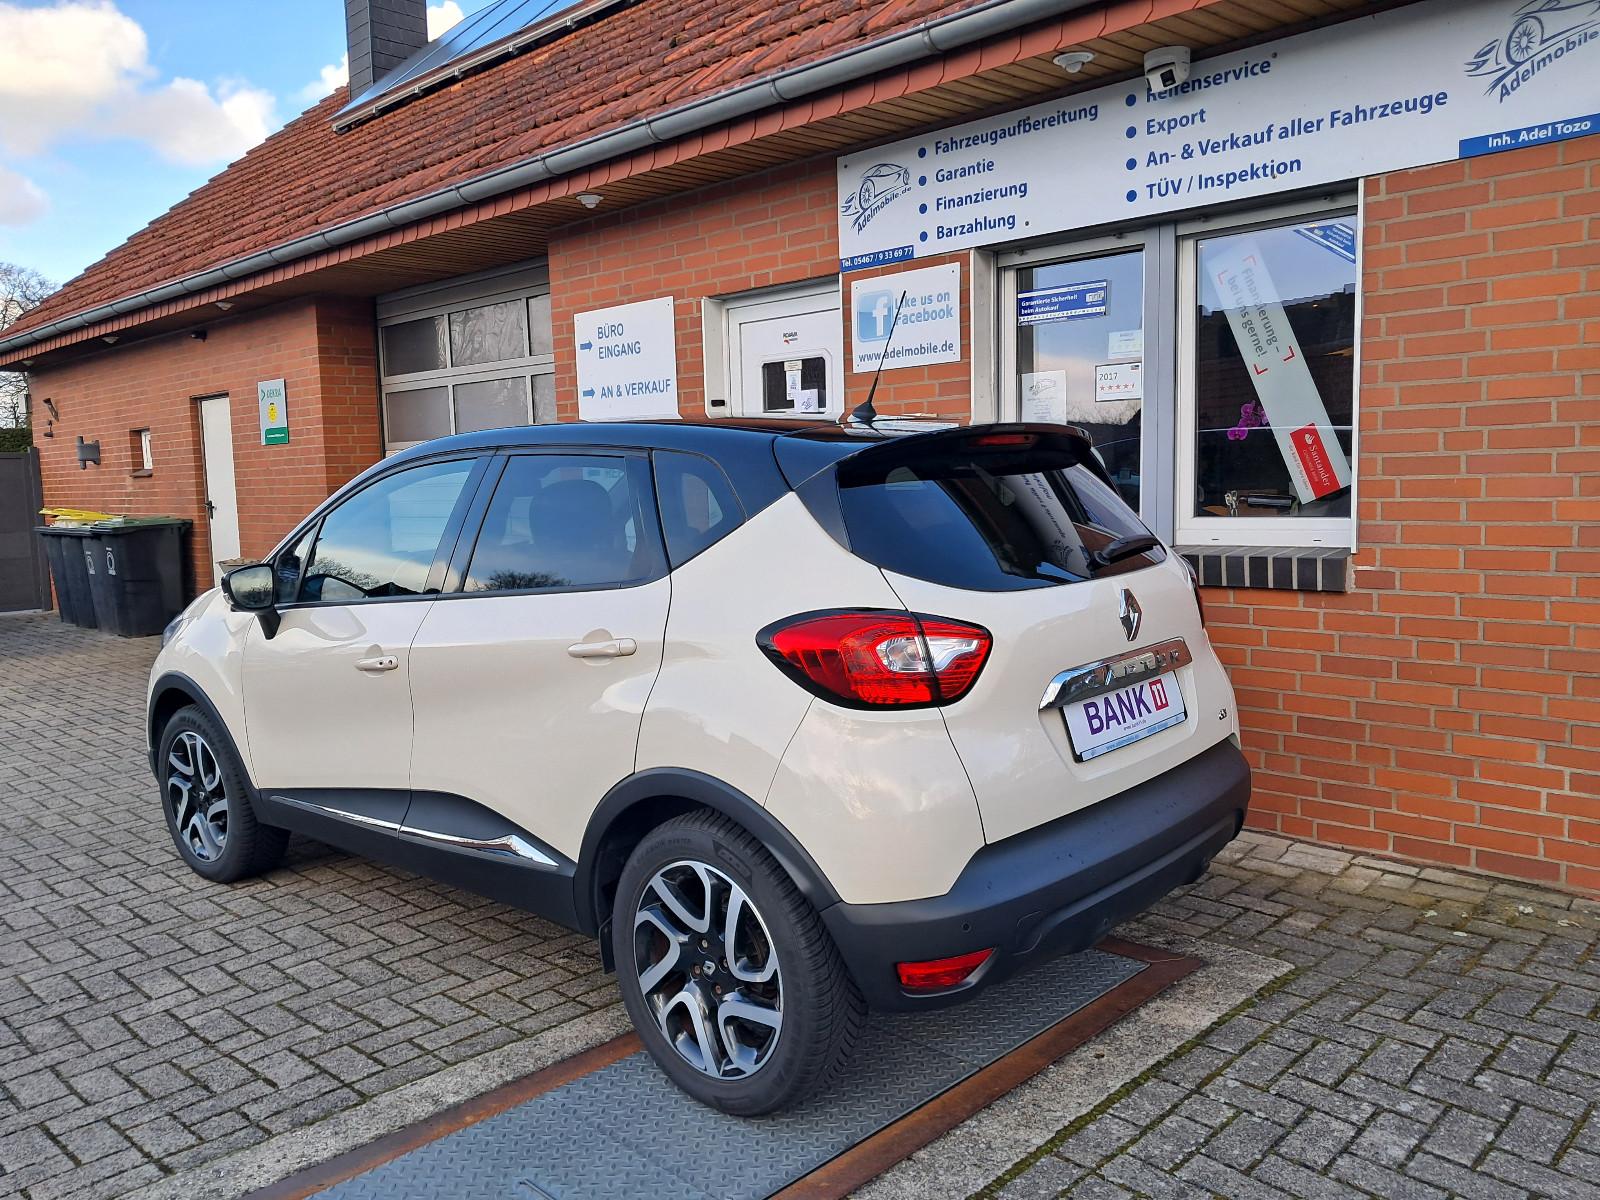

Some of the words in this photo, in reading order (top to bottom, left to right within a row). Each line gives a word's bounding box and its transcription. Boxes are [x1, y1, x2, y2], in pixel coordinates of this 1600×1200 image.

[1500, 31, 1599, 104] Adelmobile
[935, 104, 1099, 155] Fahrzeugaufbereitung
[1146, 149, 1176, 168] An-
[1181, 142, 1194, 160] &
[1198, 124, 1273, 157] Verkauf
[1278, 117, 1324, 141] aller
[1330, 91, 1448, 129] Fahrzeuge
[1147, 108, 1206, 137] Export
[1488, 133, 1515, 148] Inh.
[1518, 125, 1551, 142] Adel
[1555, 120, 1591, 135] Tozo
[935, 158, 994, 184] Garantie
[1146, 177, 1183, 200] TÜV
[1187, 175, 1194, 194] /
[1198, 156, 1302, 191] Inspektion
[857, 186, 911, 235] Adelmobile.de
[935, 181, 1028, 212] Finanzierung
[936, 212, 1016, 240] Barzahlung
[842, 259, 853, 268] Tel.
[854, 256, 873, 266] 05467
[884, 252, 892, 260] 33
[894, 249, 903, 258] 69
[904, 247, 913, 256] 77
[920, 294, 933, 306] us
[936, 291, 950, 303] on
[597, 322, 624, 340] BÜRO
[1241, 319, 1268, 358] gerne!
[598, 340, 641, 360] EINGANG
[859, 340, 954, 362] wwwadelmobile.de
[600, 386, 614, 399] AN
[616, 384, 623, 397] &
[624, 378, 671, 396] VERKAUF
[1099, 372, 1118, 381] 2017
[1310, 444, 1330, 486] Santander
[1083, 684, 1152, 736] BANK
